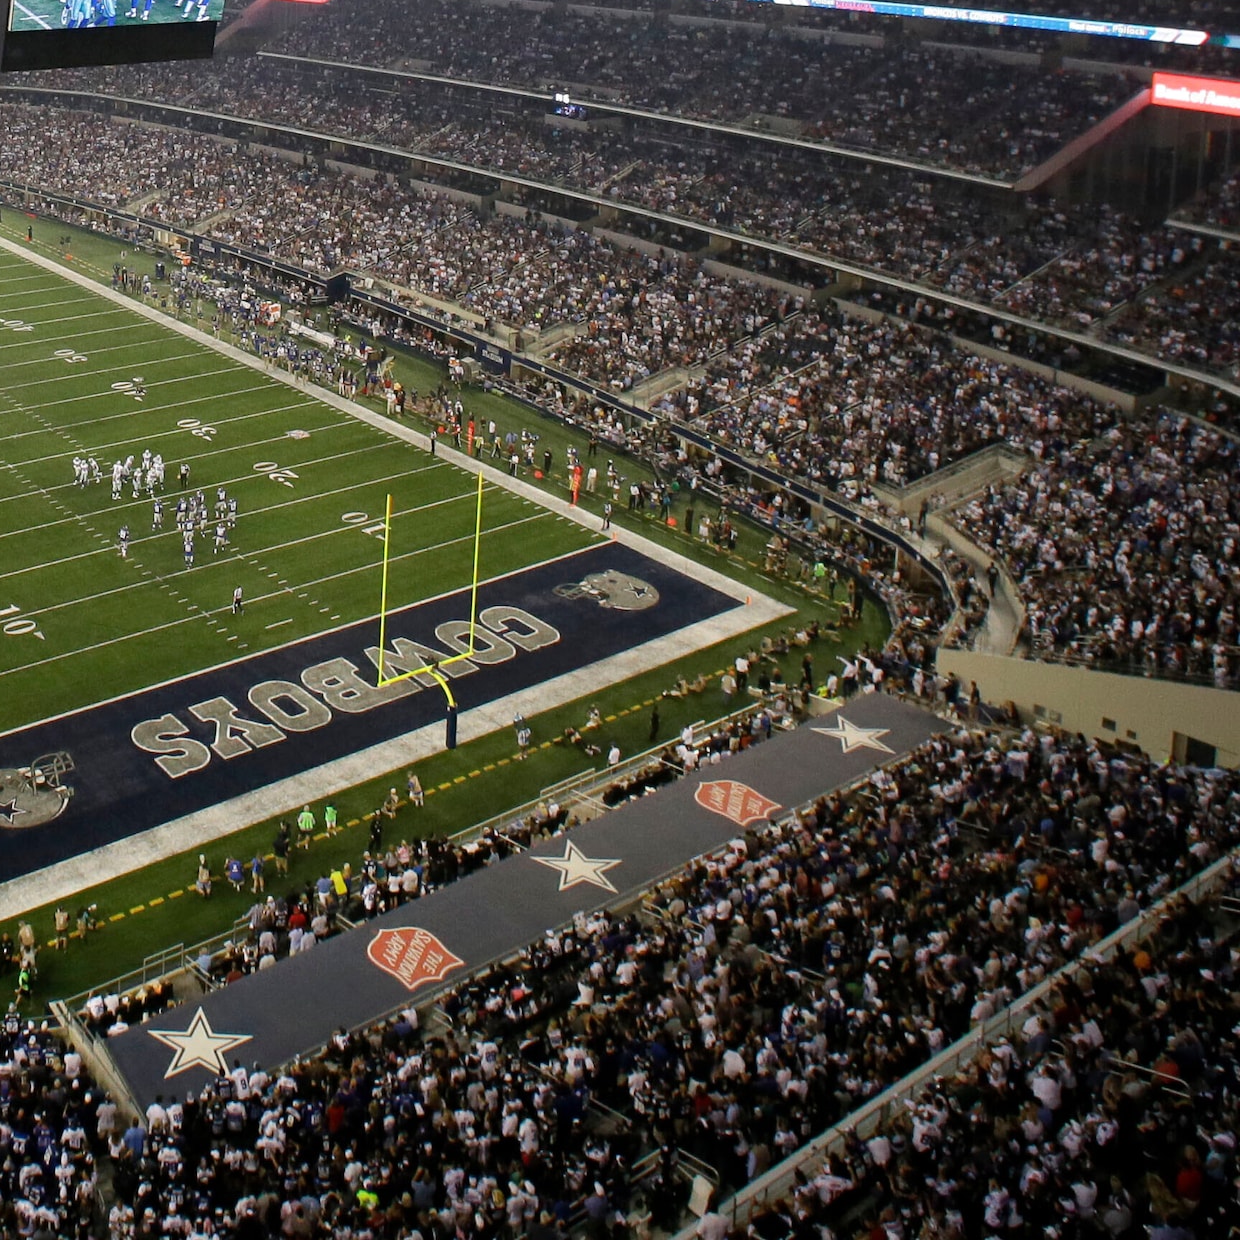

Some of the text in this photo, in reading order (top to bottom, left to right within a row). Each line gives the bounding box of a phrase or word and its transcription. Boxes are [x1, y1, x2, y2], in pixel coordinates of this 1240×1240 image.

[1155, 83, 1189, 102] Bank
[1190, 89, 1206, 104] of
[54, 348, 89, 363] 50
[176, 418, 217, 438] 30
[252, 461, 300, 483] 20
[130, 605, 561, 779] COWBOYS
[382, 931, 407, 967] ARMY
[397, 931, 432, 982] SALVATION
[422, 950, 444, 975] THE
